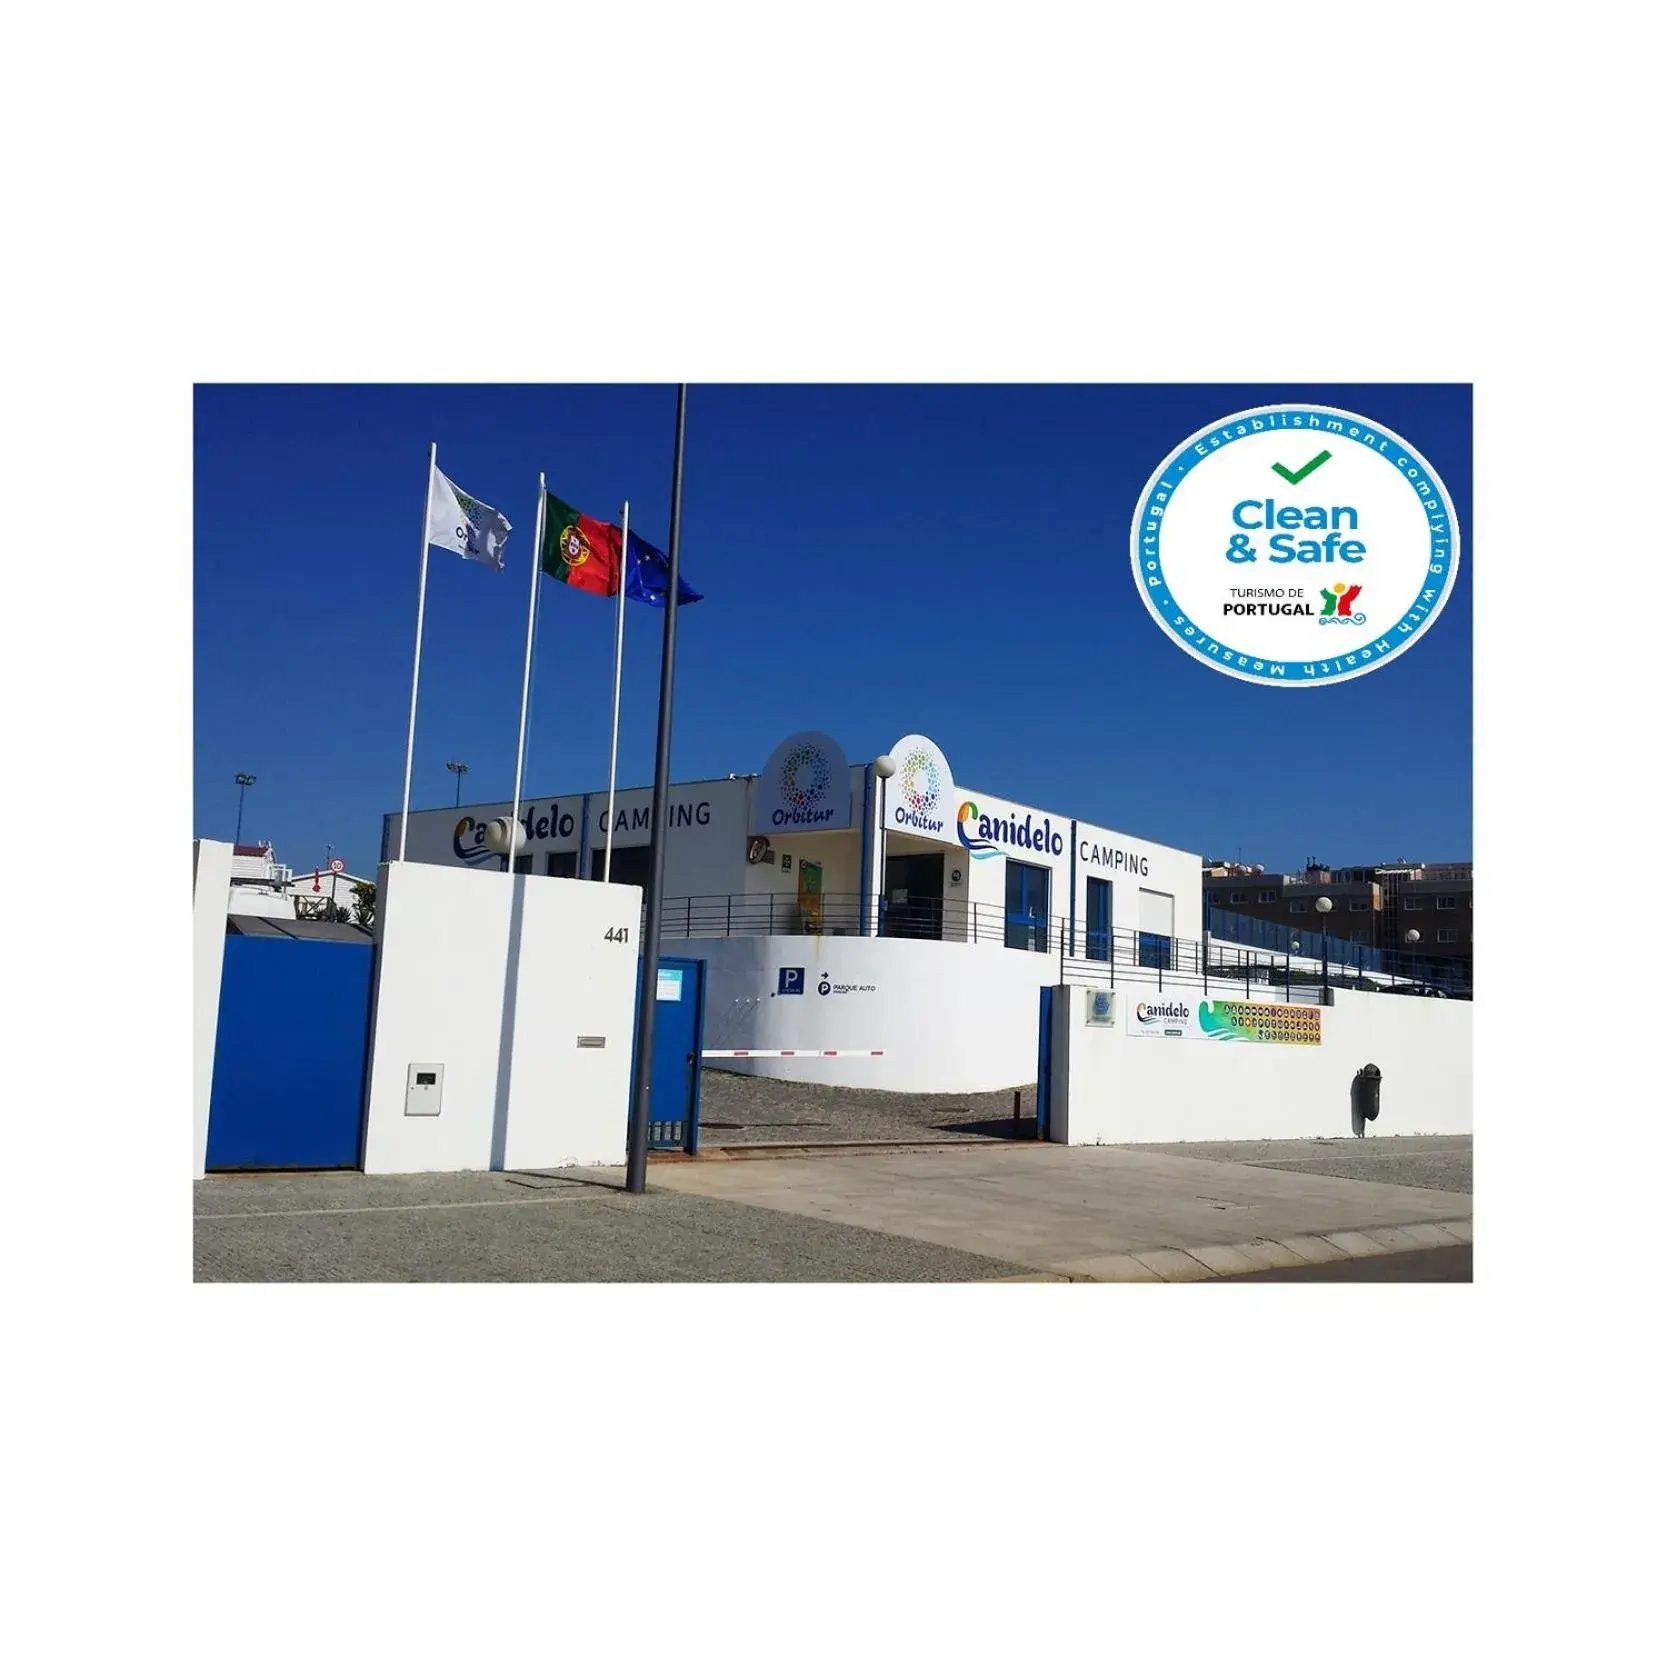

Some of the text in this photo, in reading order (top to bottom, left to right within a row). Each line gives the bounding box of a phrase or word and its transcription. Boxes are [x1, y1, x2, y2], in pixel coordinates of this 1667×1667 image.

[772, 806, 834, 826] Orbitur
[895, 806, 944, 833] Orbitur
[453, 801, 711, 859] Cadelo CAMING
[957, 801, 1149, 877] Canidelo CAMPING
[604, 926, 629, 943] 441
[785, 969, 798, 988] P
[833, 984, 857, 992] PARQUE
[1137, 1002, 1190, 1022] Canidelo
